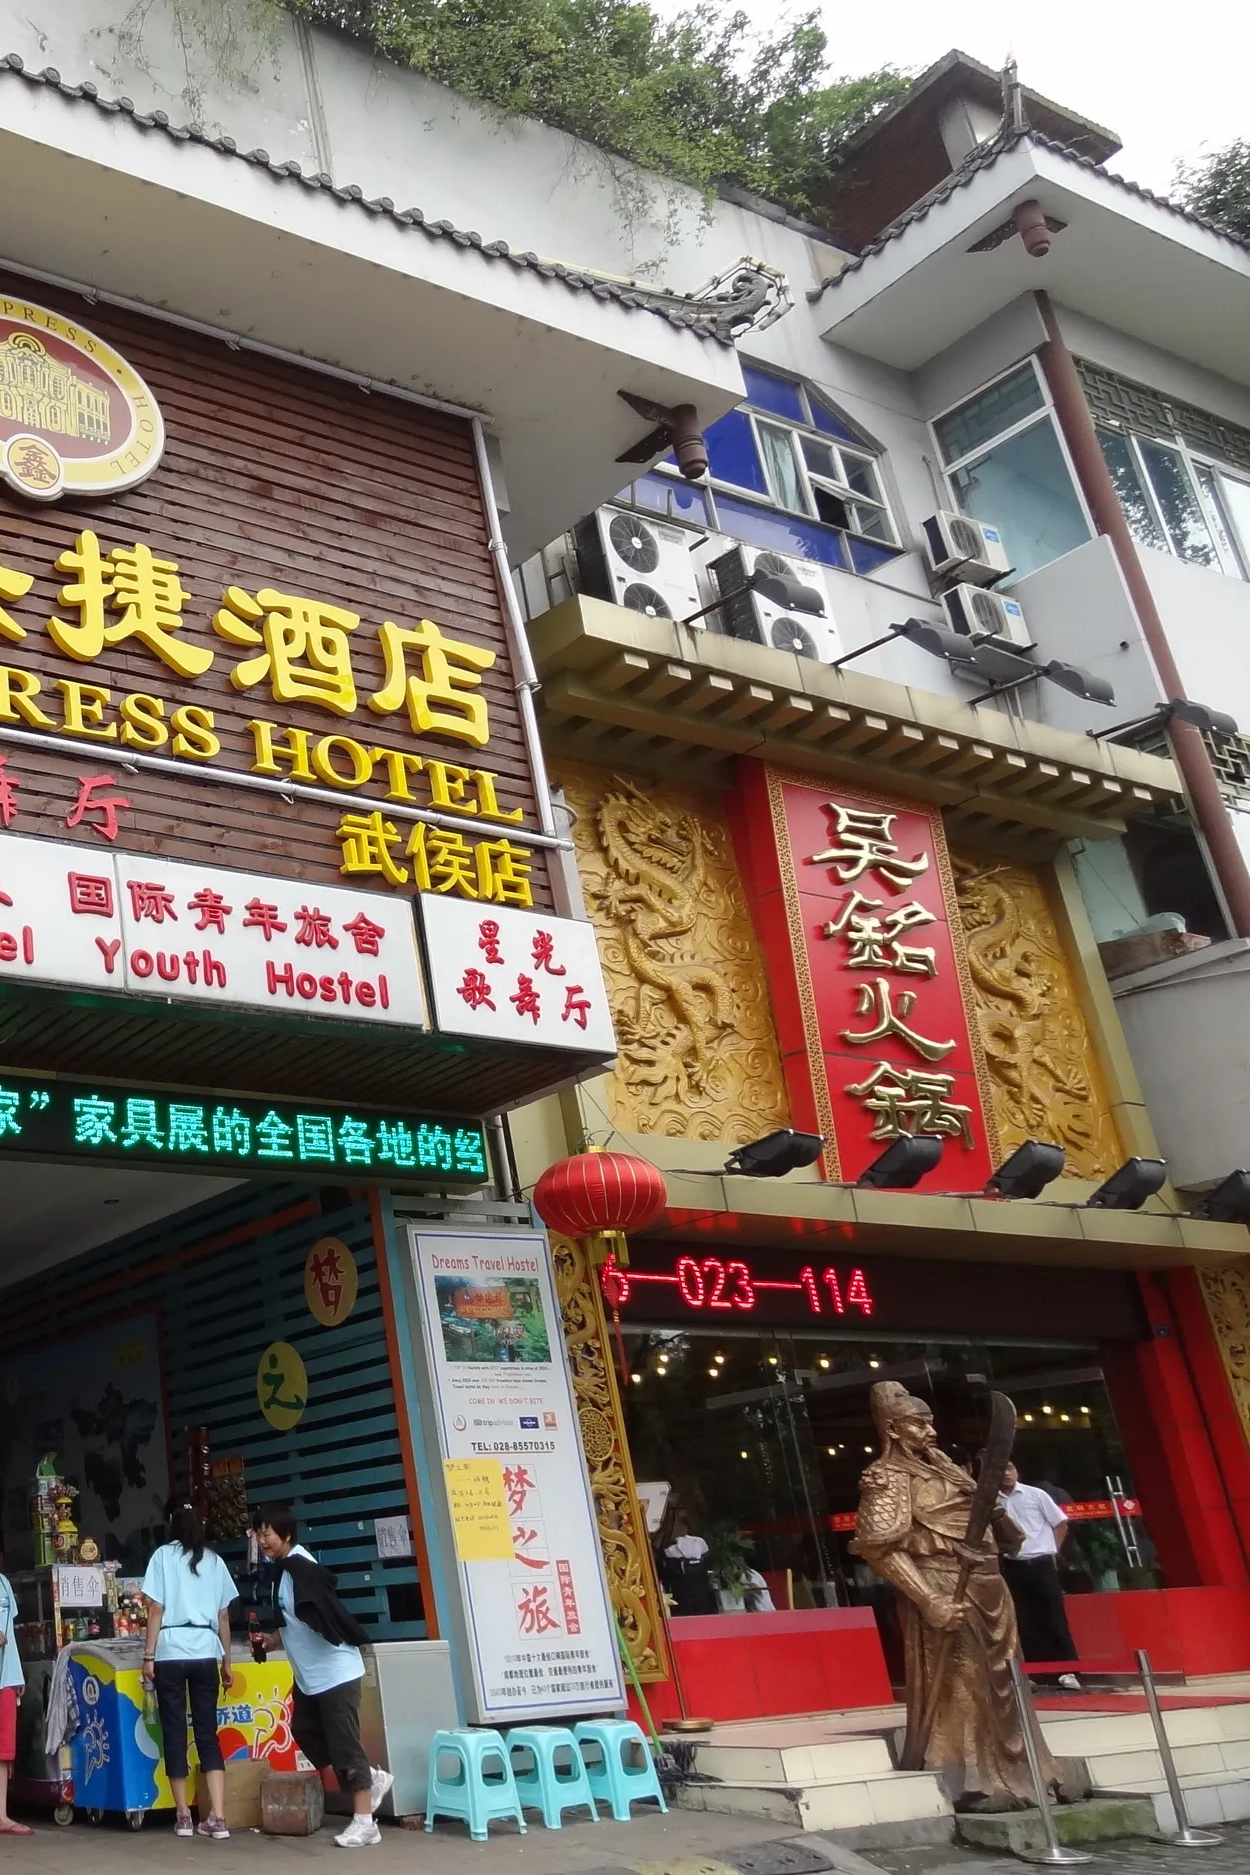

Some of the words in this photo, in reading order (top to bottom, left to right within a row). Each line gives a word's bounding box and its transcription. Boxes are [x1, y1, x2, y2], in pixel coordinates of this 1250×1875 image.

[14, 443, 56, 484] 鑫
[110, 395, 154, 475] HOTEL
[250, 720, 524, 824] HOTEL
[336, 812, 534, 909] 武侯店
[67, 871, 386, 957] 国际青年旅舍
[95, 937, 227, 989] Youth
[266, 958, 390, 1010] Hostel
[477, 919, 567, 976] 星光
[457, 968, 592, 1031] 歌舞厅
[431, 1253, 469, 1270] Dreams
[471, 1255, 504, 1271] Travel
[507, 1256, 539, 1272] Hostel
[262, 1352, 305, 1411] 之
[471, 1441, 492, 1452] TEL:
[493, 1441, 555, 1452] 028-85570315
